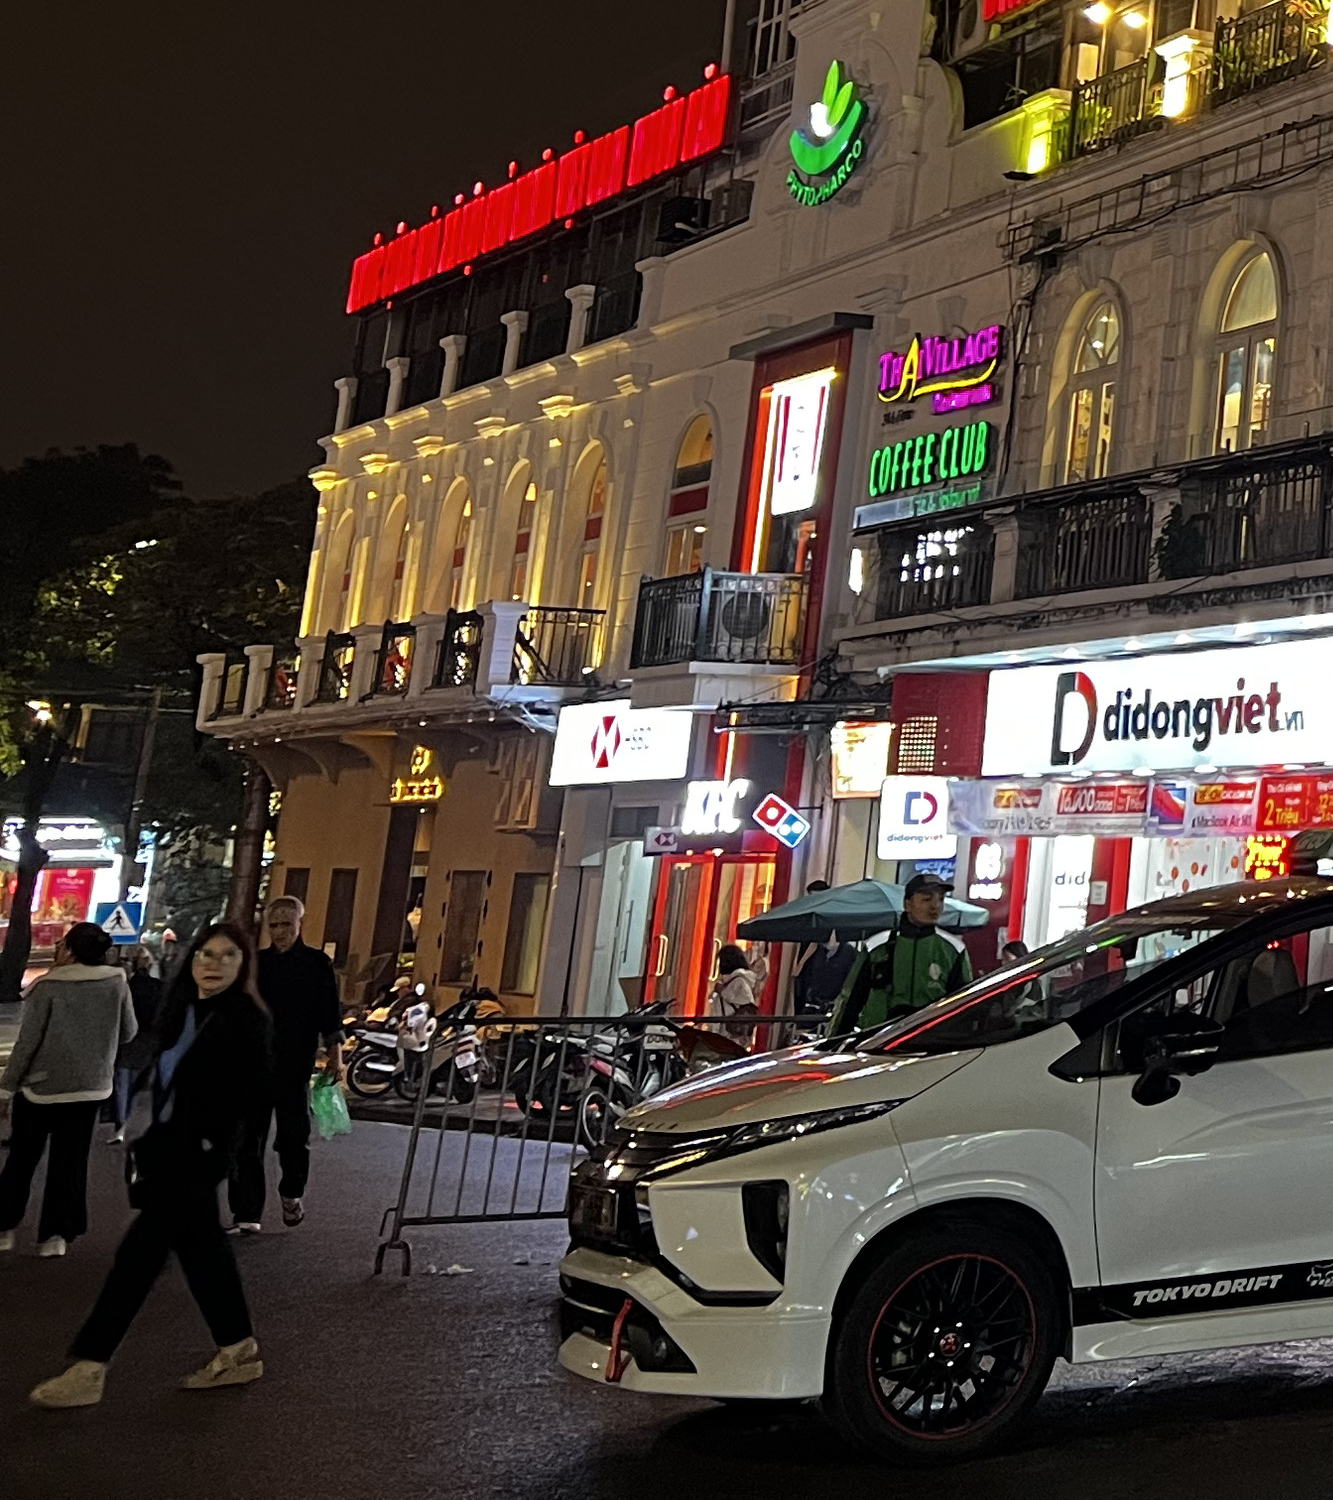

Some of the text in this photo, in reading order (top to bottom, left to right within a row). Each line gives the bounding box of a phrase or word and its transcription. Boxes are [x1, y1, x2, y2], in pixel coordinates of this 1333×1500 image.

[869, 433, 935, 497] COFFEE
[939, 421, 988, 479] CLUB
[1264, 800, 1275, 825] 2
[1133, 1283, 1211, 1306] TOKYO
[1212, 1274, 1283, 1297] DRIFT
